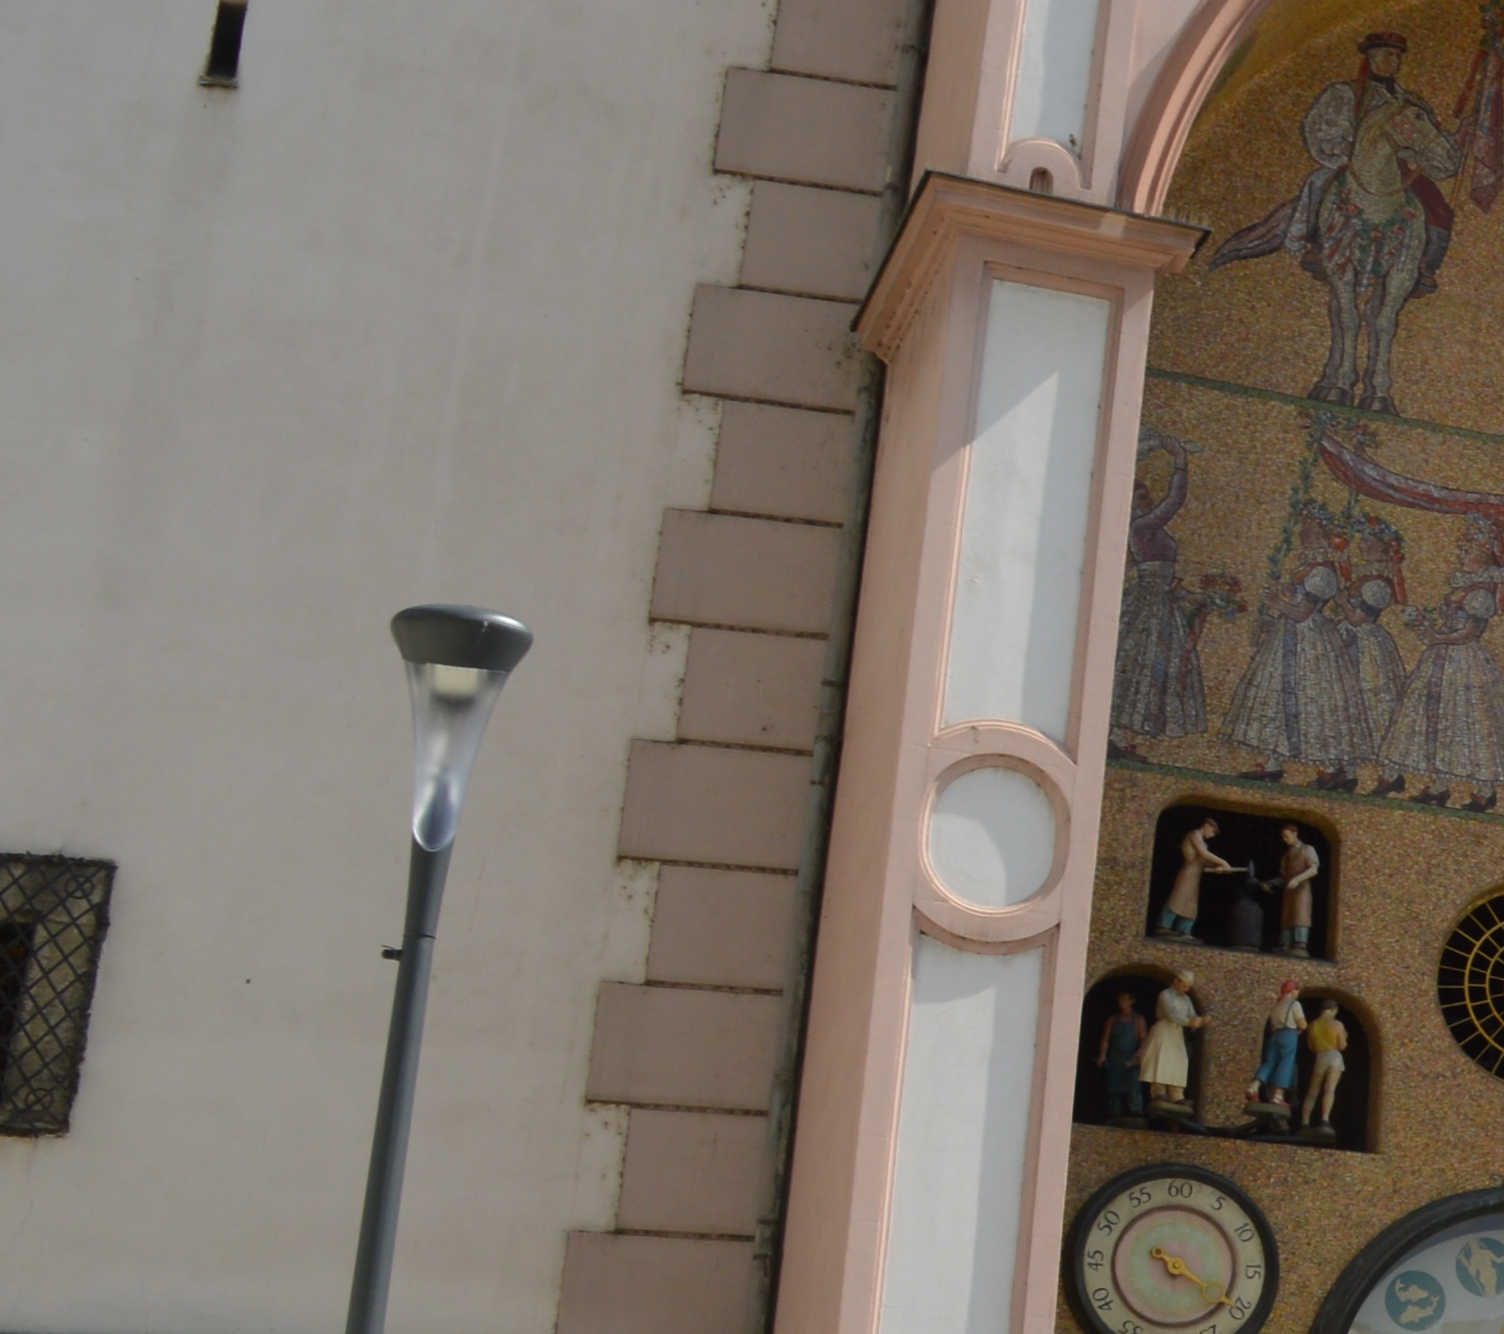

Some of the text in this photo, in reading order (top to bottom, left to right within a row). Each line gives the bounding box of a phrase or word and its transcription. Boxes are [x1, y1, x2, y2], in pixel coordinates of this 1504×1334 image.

[1128, 1187, 1152, 1208] 55
[1167, 1181, 1193, 1199] 60
[1210, 1195, 1227, 1211] 5
[1097, 1209, 1120, 1236] 50
[1234, 1222, 1255, 1243] 10
[1087, 1250, 1104, 1272] 45
[1245, 1263, 1262, 1281] 15
[1091, 1287, 1113, 1312] 40
[1228, 1295, 1252, 1321] 20
